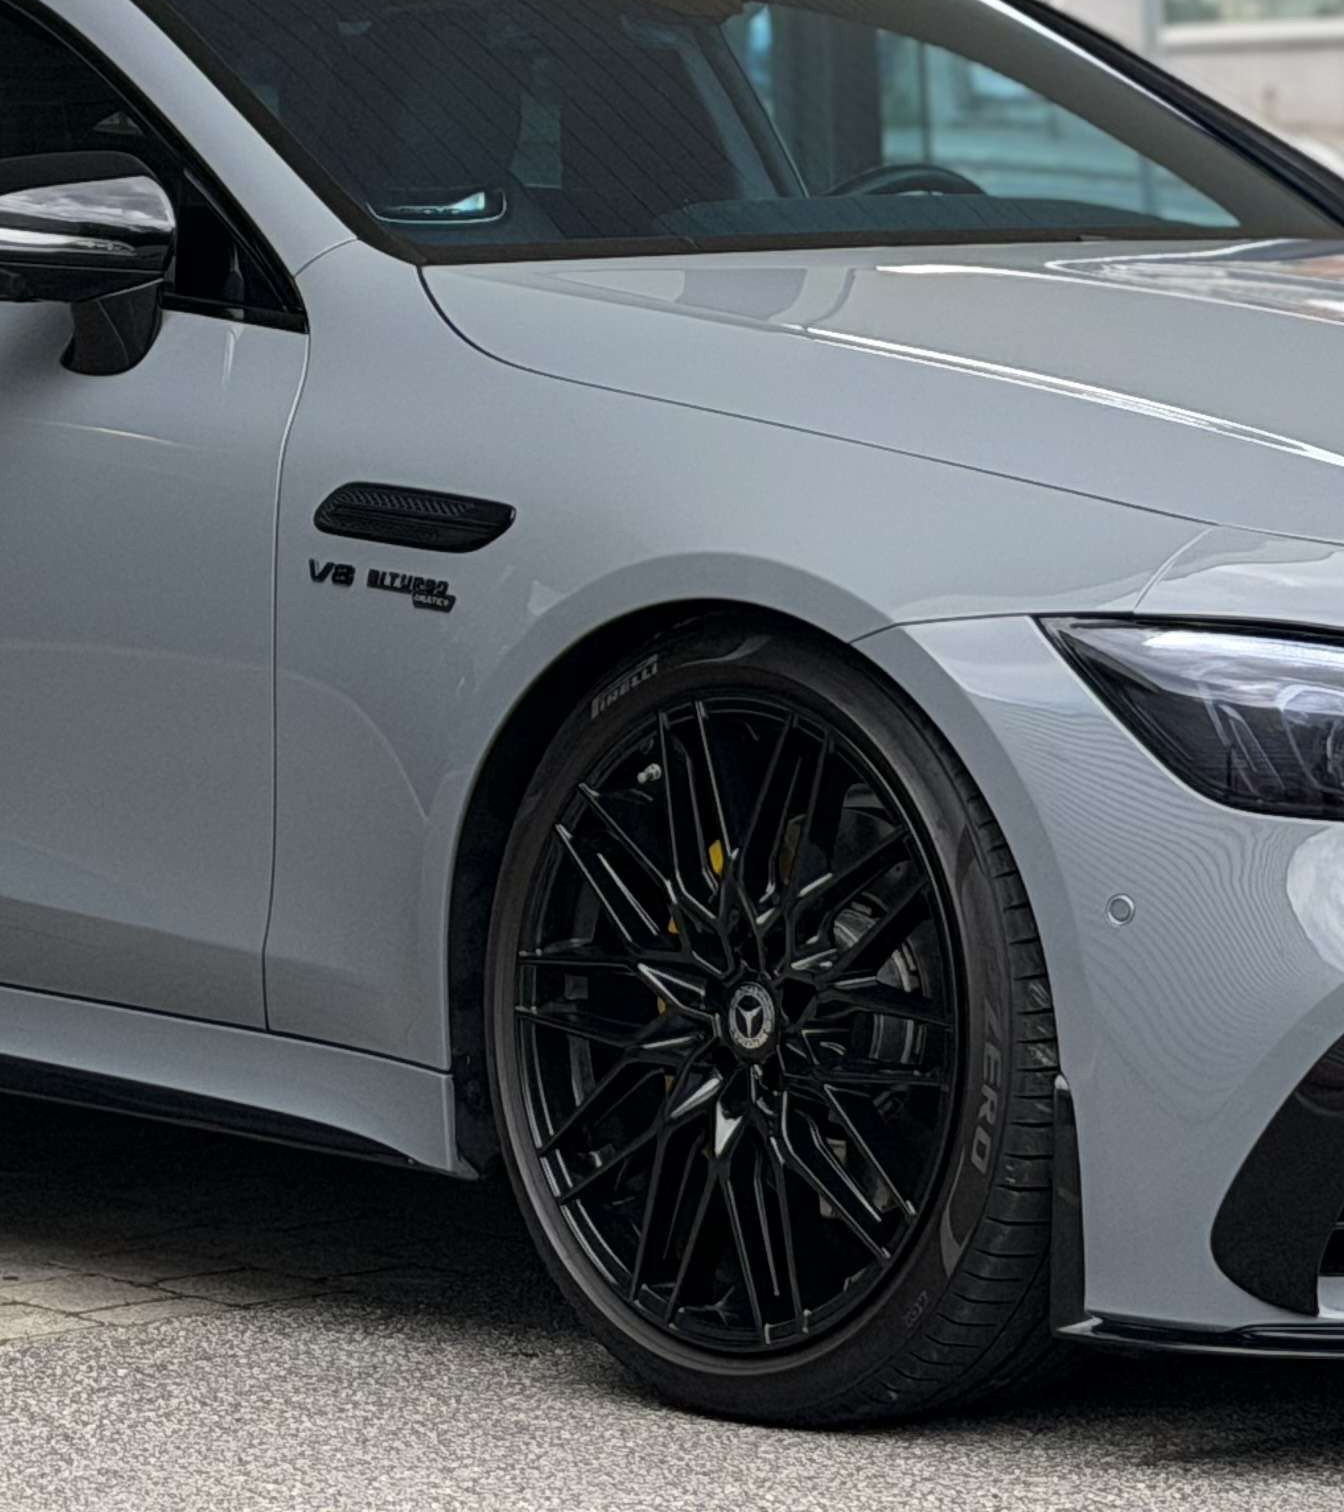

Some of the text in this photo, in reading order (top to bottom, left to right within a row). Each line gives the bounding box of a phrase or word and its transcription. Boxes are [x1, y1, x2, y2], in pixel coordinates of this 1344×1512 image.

[309, 558, 449, 596] V8 BITURBO
[591, 653, 659, 720] PIRELLI
[970, 997, 1004, 1175] ZERO
